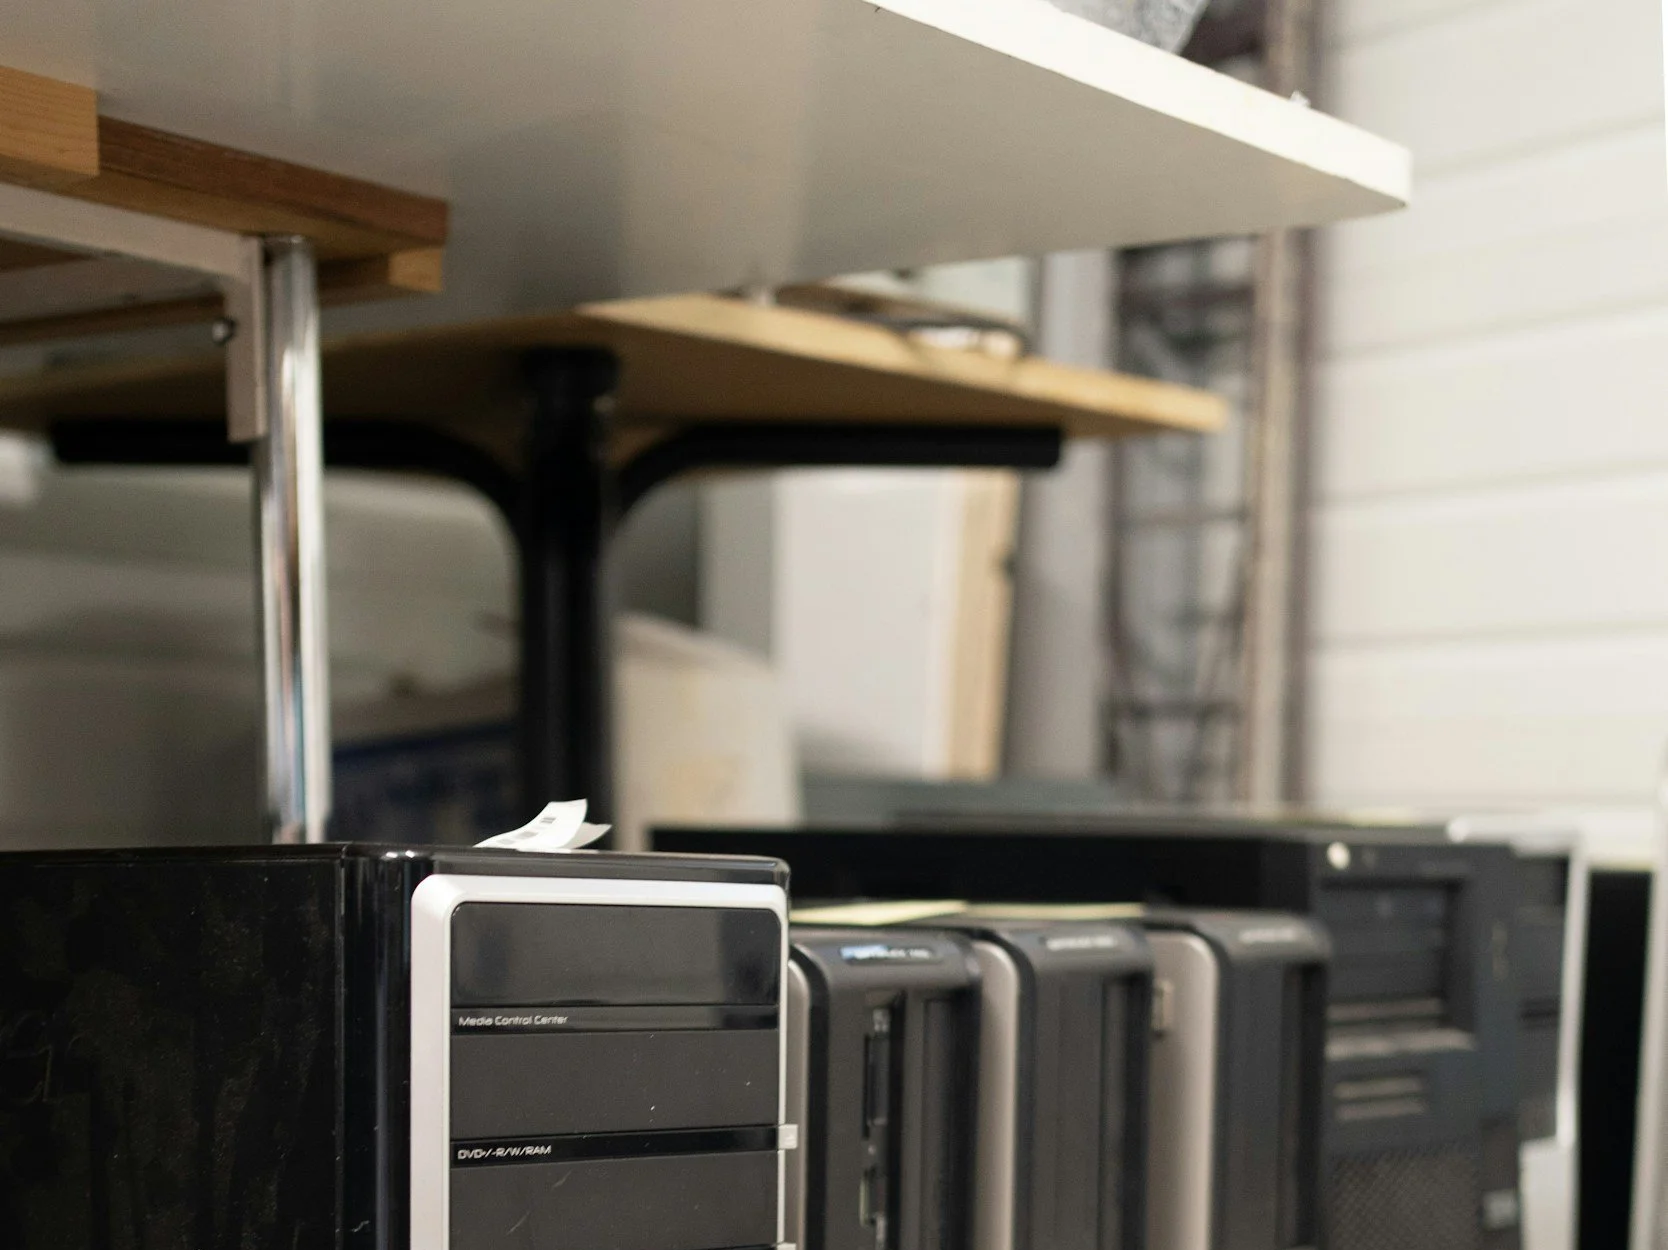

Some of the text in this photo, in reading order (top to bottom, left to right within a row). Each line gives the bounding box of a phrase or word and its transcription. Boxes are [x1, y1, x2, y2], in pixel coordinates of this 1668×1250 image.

[458, 1015, 568, 1026] Media Control Center
